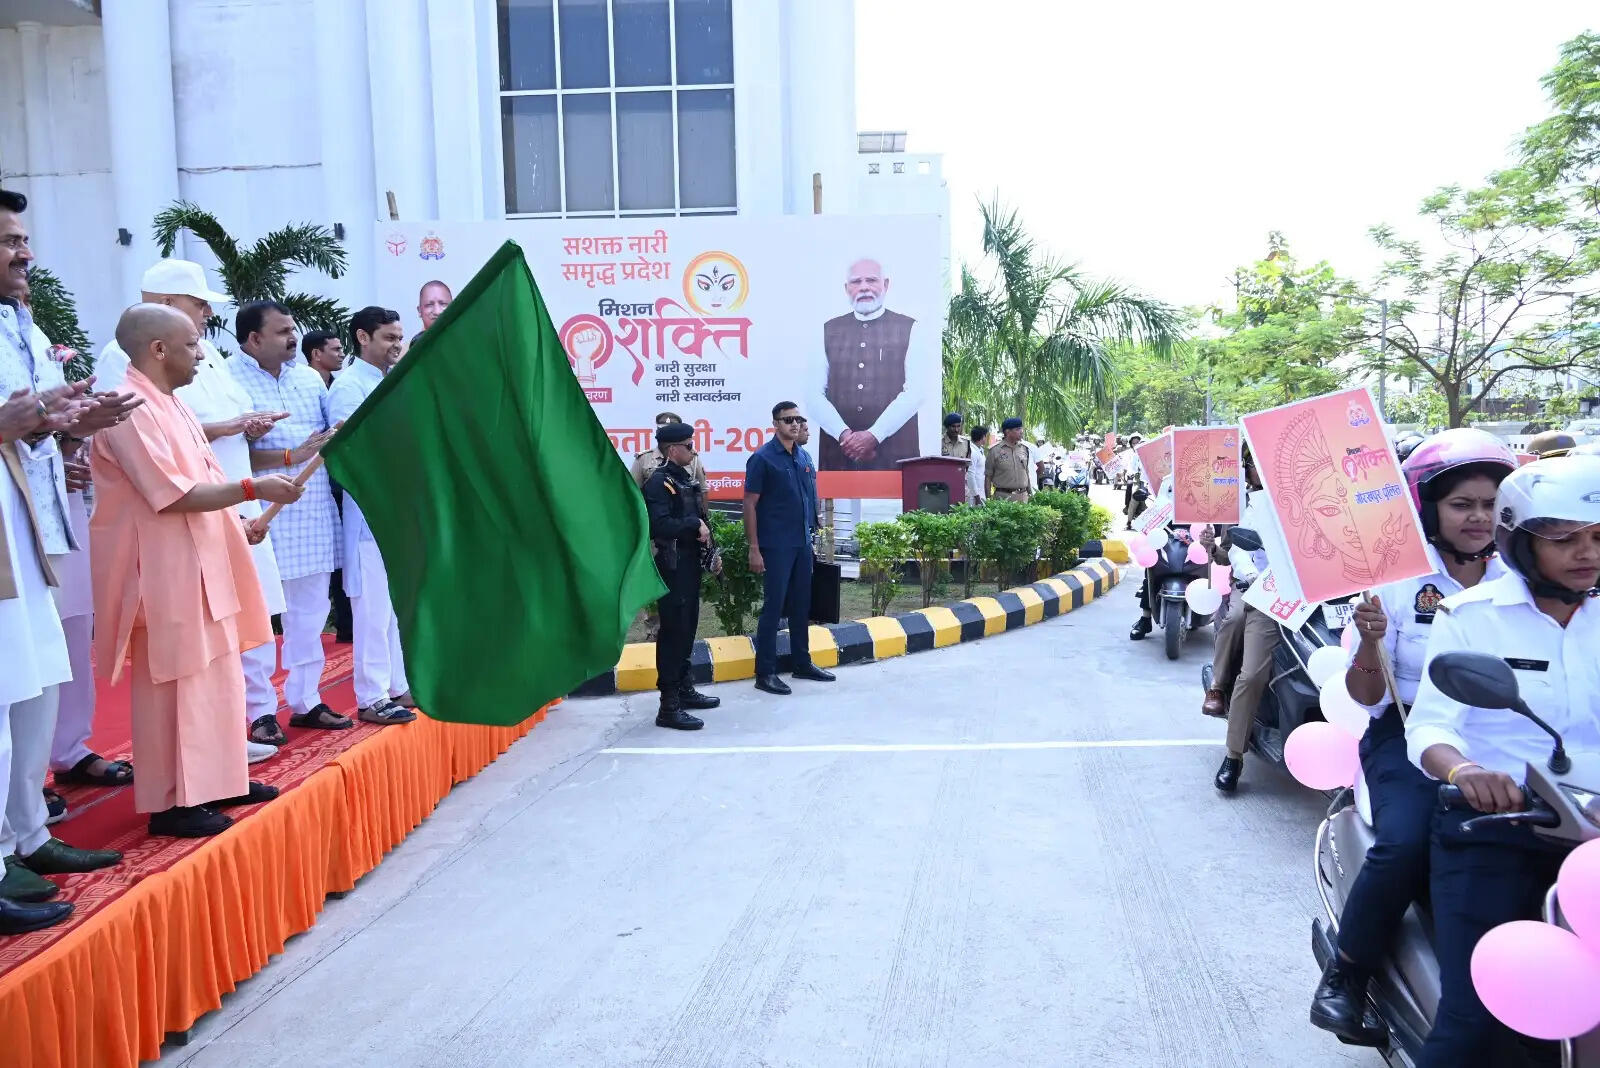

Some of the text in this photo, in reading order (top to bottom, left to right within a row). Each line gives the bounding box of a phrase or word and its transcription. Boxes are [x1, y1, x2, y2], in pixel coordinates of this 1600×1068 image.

[562, 229, 669, 255] सशक्त नारी
[561, 256, 671, 288] समृद्ध प्रदेश
[598, 298, 654, 317] मिशन
[614, 297, 754, 387] शक्ति
[655, 361, 717, 377] नारी सुरक्षा
[655, 376, 725, 388] नारी सम्मान
[655, 390, 741, 403] नारी स्वावलंबन
